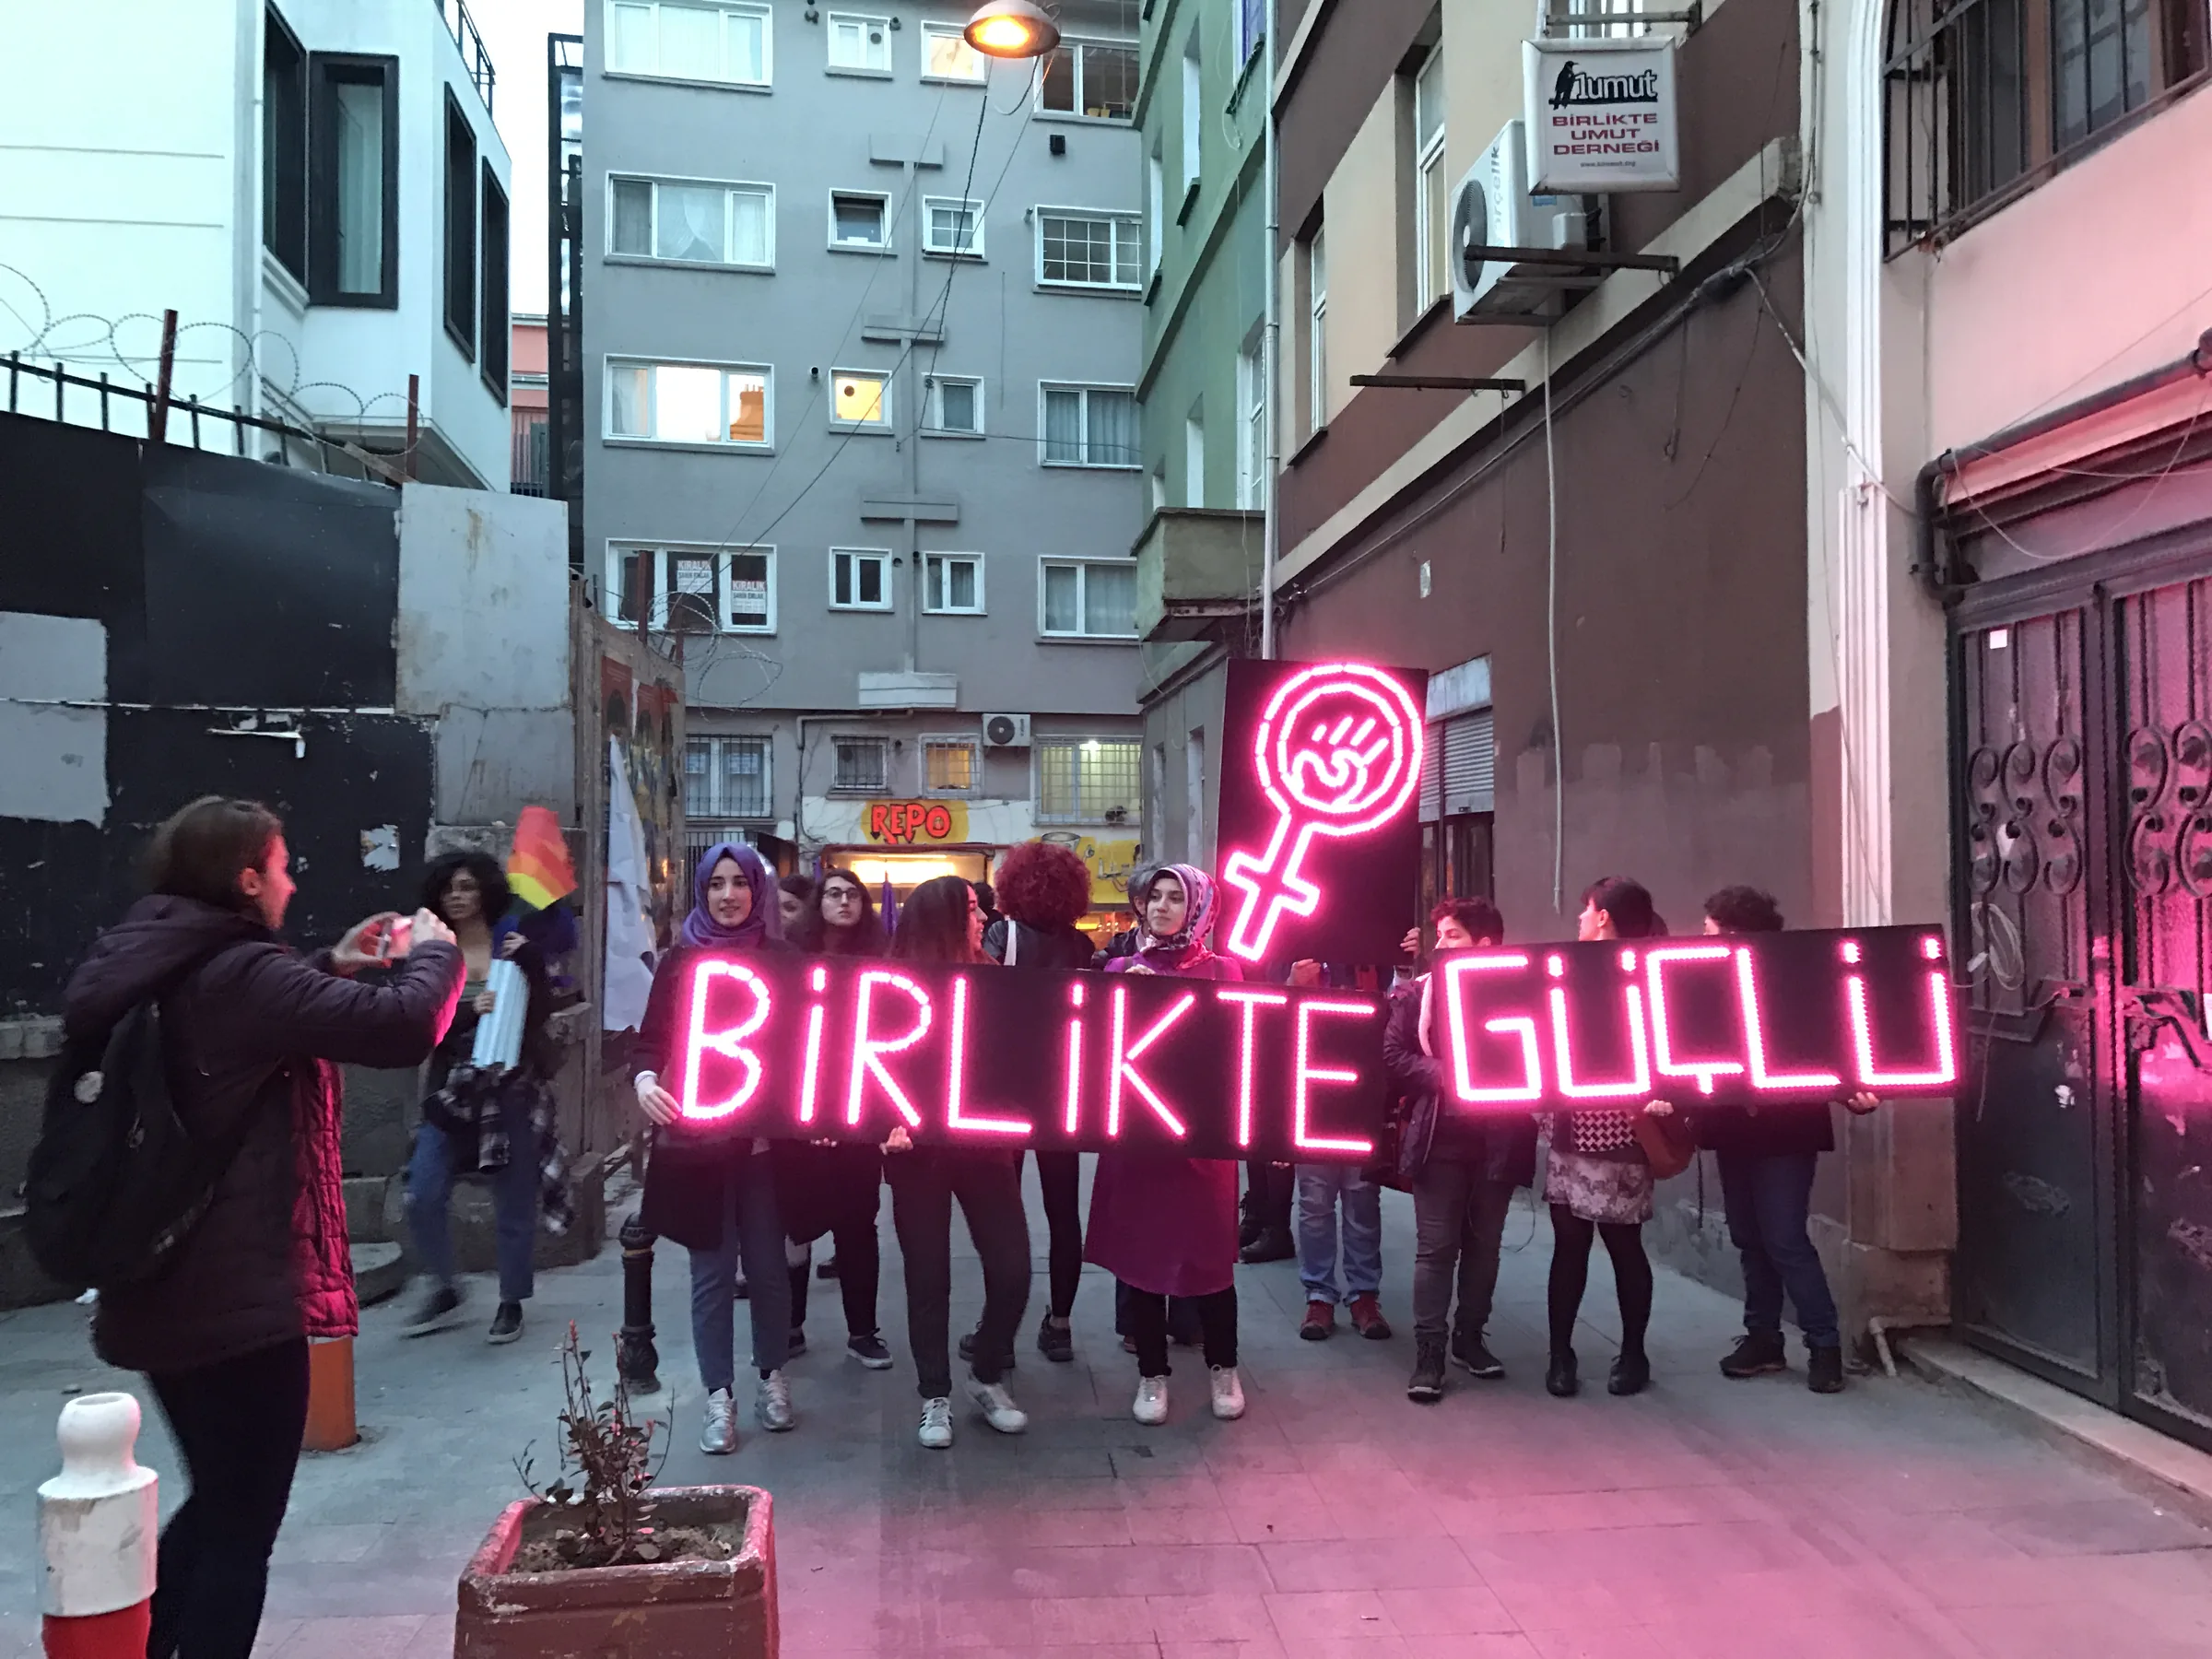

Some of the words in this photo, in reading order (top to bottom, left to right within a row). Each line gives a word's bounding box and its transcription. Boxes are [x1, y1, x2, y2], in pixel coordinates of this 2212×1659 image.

[1552, 113, 1658, 126] BİRLİKTE
[1571, 128, 1641, 140] UMUT
[871, 803, 952, 845] REPO
[1443, 937, 1957, 1101] GÜÇLÜ
